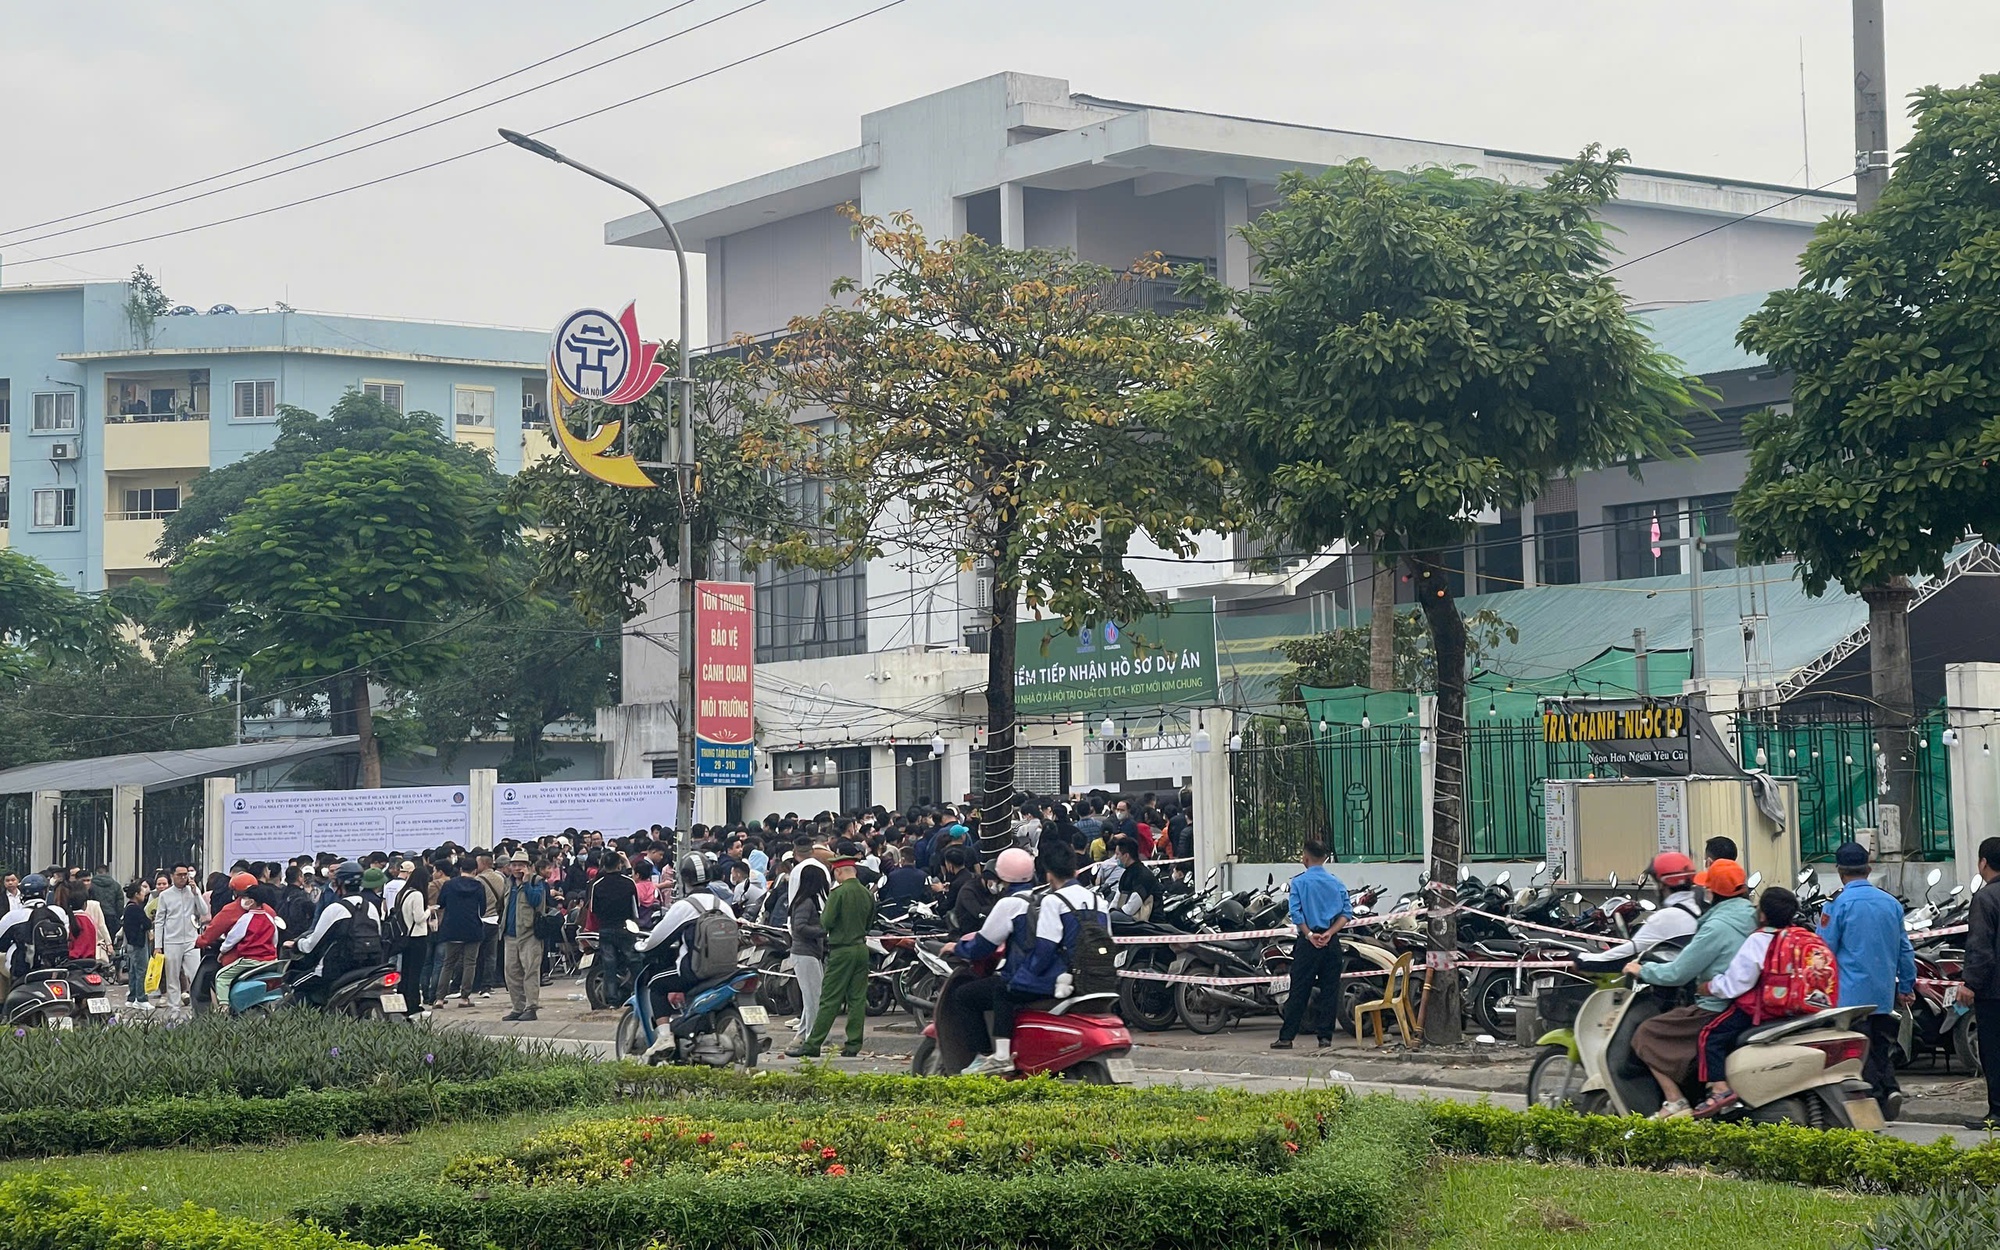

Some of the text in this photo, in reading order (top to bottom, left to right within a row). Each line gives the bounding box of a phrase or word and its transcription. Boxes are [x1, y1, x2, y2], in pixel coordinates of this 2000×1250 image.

[581, 386, 601, 398] HÀ NỘI
[702, 592, 747, 617] TÔN TRỌNG,
[711, 622, 738, 650] BẢO VỆ
[702, 657, 747, 684] CẢNH QUAN
[1014, 649, 1200, 686] IỂM TIẾP NHẬN HỒ SƠ DỰ ÁN
[1021, 692, 1035, 704] NHÀ
[1053, 690, 1065, 703] HỘI
[1066, 690, 1076, 702] TẠI
[1113, 686, 1126, 696] CT4
[1131, 683, 1145, 694] KĐT
[1146, 680, 1160, 692] MỚI
[1162, 680, 1175, 691] KIM
[1176, 677, 1203, 689] CHUNG
[701, 696, 749, 718] MÔI TRƯỜNG
[1572, 711, 1616, 742] CHANH
[1588, 754, 1608, 764] Ngon
[1610, 752, 1626, 762] Hơn
[1654, 751, 1669, 760] Yêu
